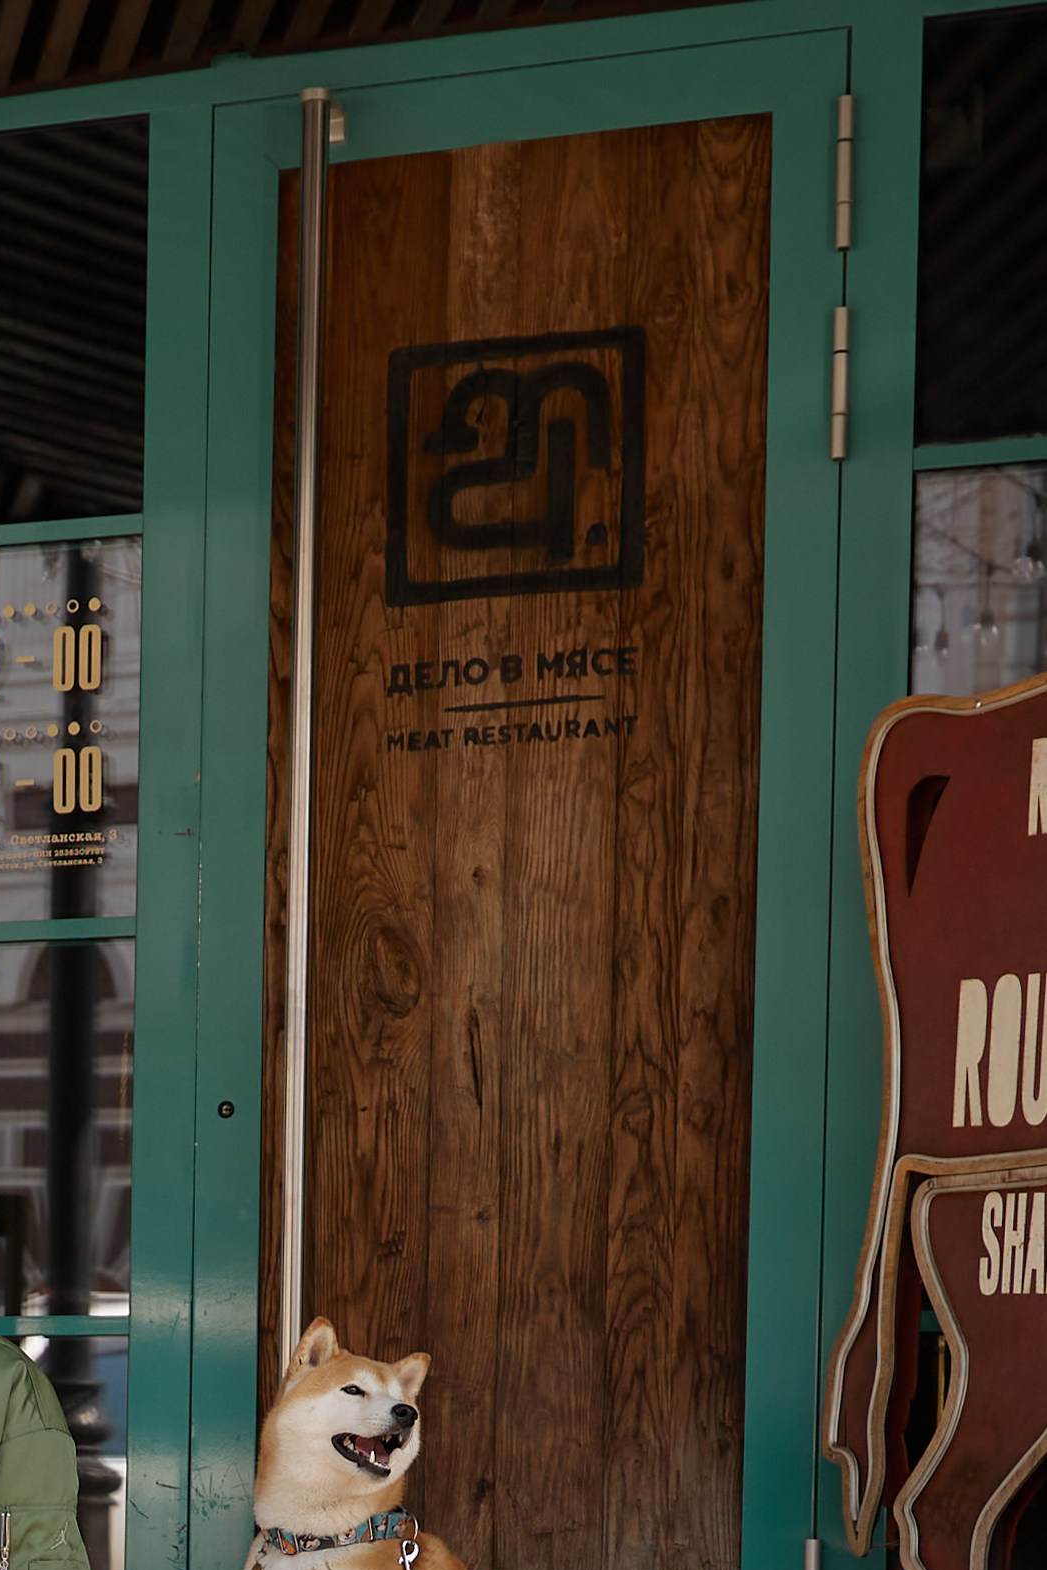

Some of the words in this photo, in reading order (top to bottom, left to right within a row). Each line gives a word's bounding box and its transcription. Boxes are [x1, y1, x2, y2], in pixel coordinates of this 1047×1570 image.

[53, 624, 101, 691] 00
[387, 657, 489, 698] ДЕЛО
[501, 654, 523, 684] В
[537, 646, 639, 681] МЯСЕ
[386, 729, 453, 752] MEAT
[464, 715, 638, 747] RESTAURANT
[53, 746, 102, 814] 00
